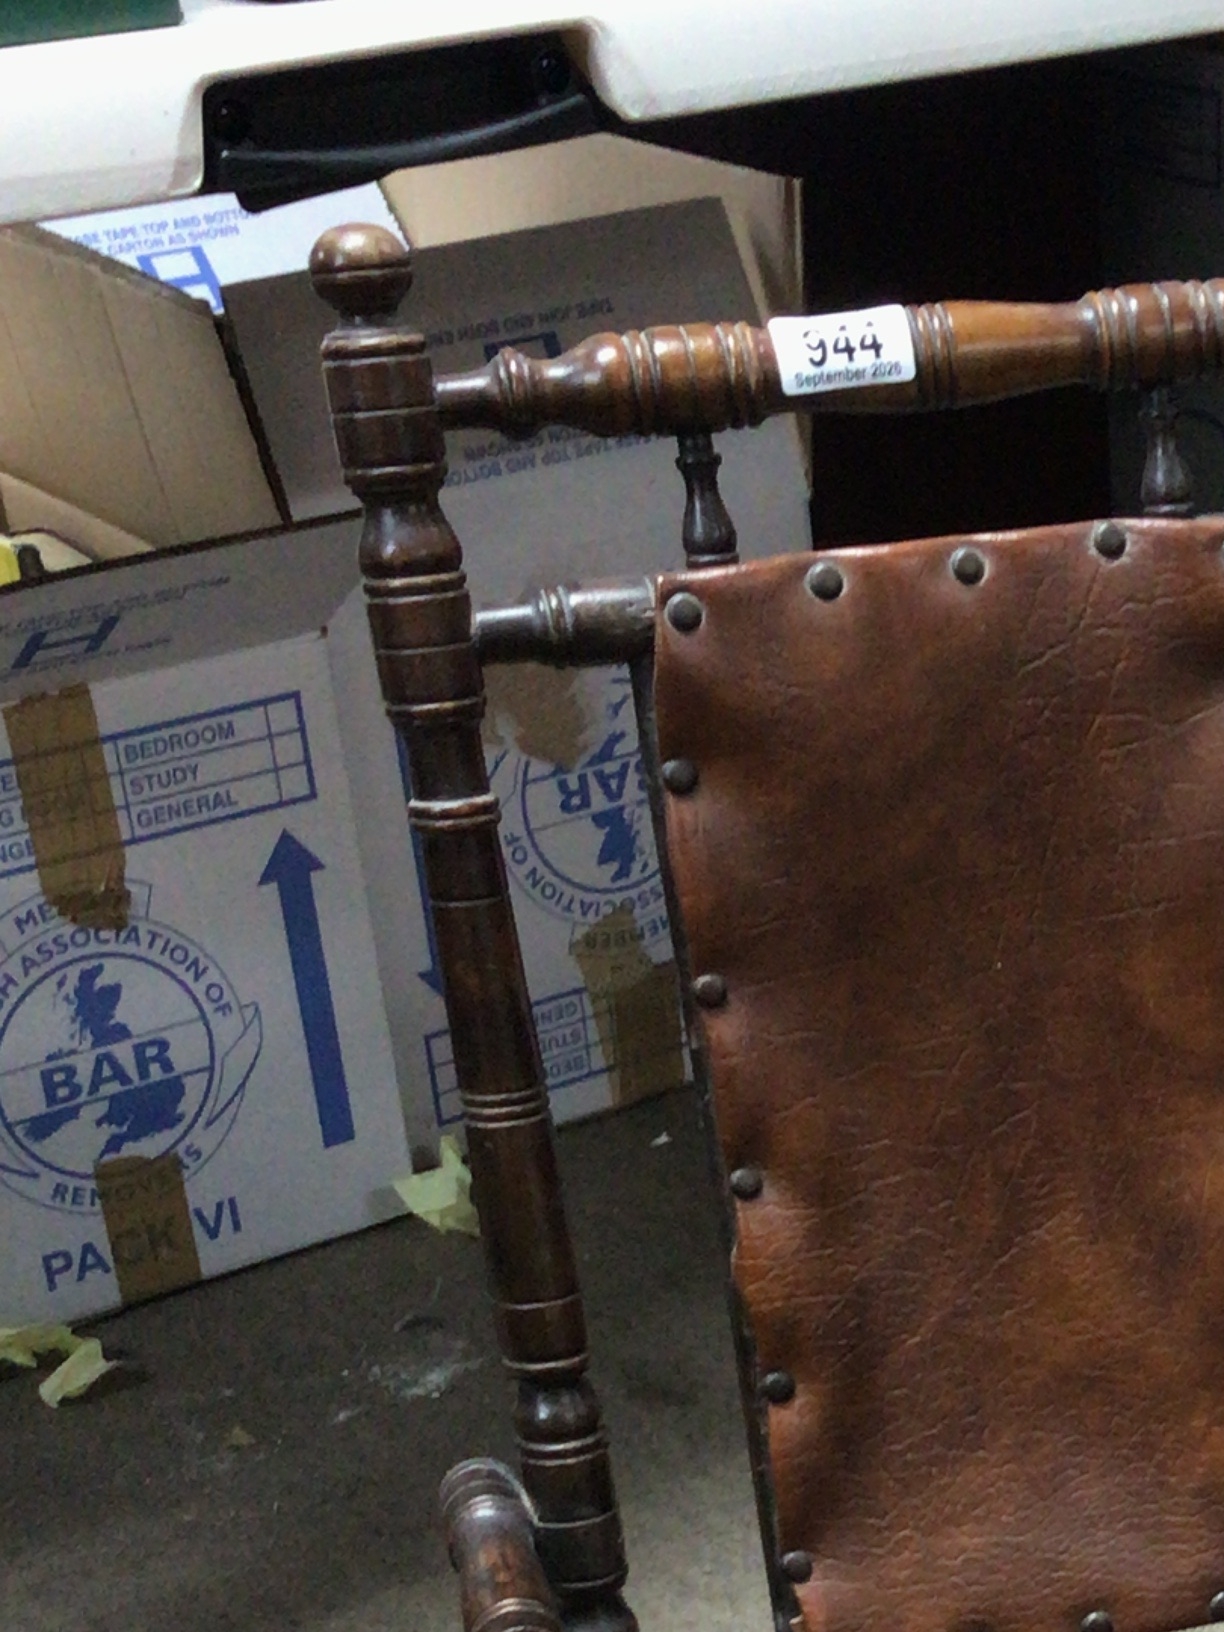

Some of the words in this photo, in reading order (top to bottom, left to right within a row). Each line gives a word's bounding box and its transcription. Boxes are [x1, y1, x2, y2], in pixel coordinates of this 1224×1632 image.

[142, 219, 169, 235] TOP
[173, 214, 201, 230] AND
[203, 206, 252, 225] BOTTO
[802, 320, 884, 368] 944
[794, 366, 867, 389] September
[444, 460, 503, 488] BOTTO
[504, 453, 537, 474] AND
[541, 448, 571, 467] TOP
[124, 719, 236, 764] BEDROOM
[129, 763, 201, 796] STUDY
[136, 789, 239, 829] GENERAL
[20, 924, 210, 984] ASSOCIATION
[205, 982, 233, 1018] OF
[39, 1037, 176, 1109] BAR
[193, 1195, 243, 1241] VI
